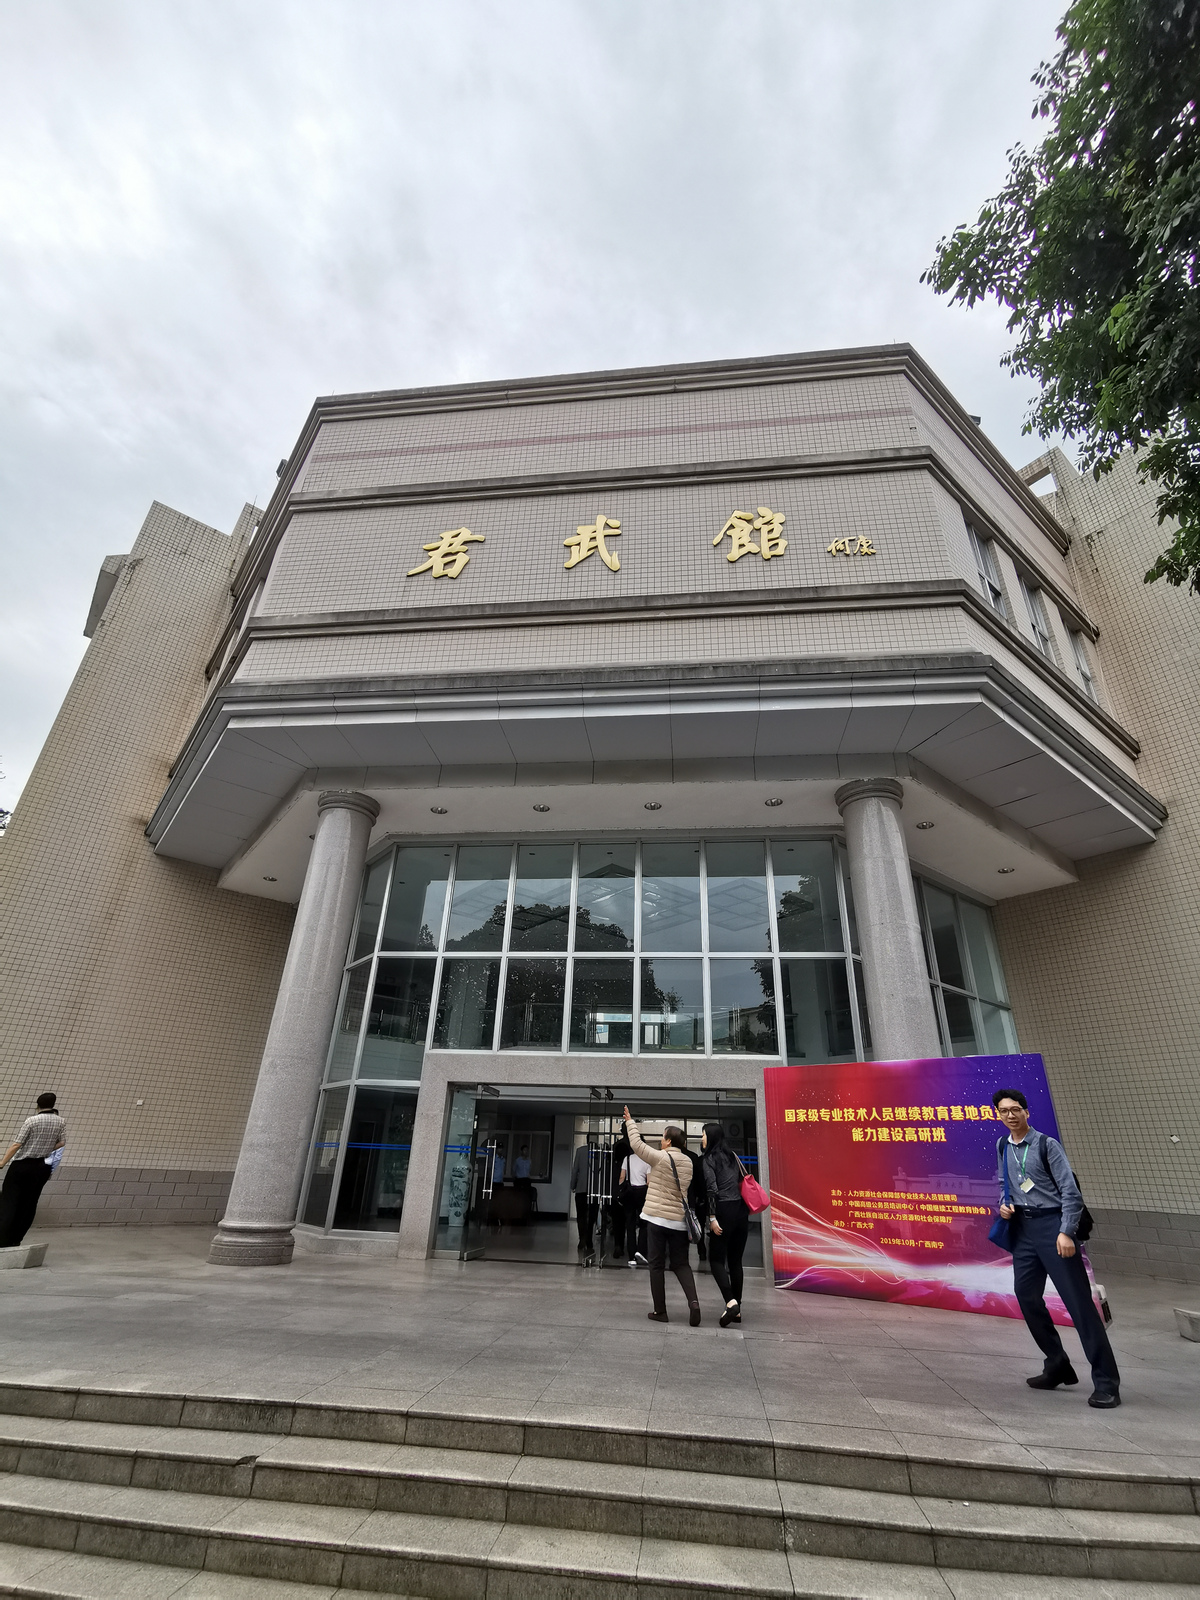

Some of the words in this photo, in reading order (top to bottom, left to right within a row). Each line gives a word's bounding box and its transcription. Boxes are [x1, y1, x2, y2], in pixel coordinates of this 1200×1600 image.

[852, 1127, 947, 1143] 能力建设高研班
[833, 1220, 875, 1230] 承办：广西大学
